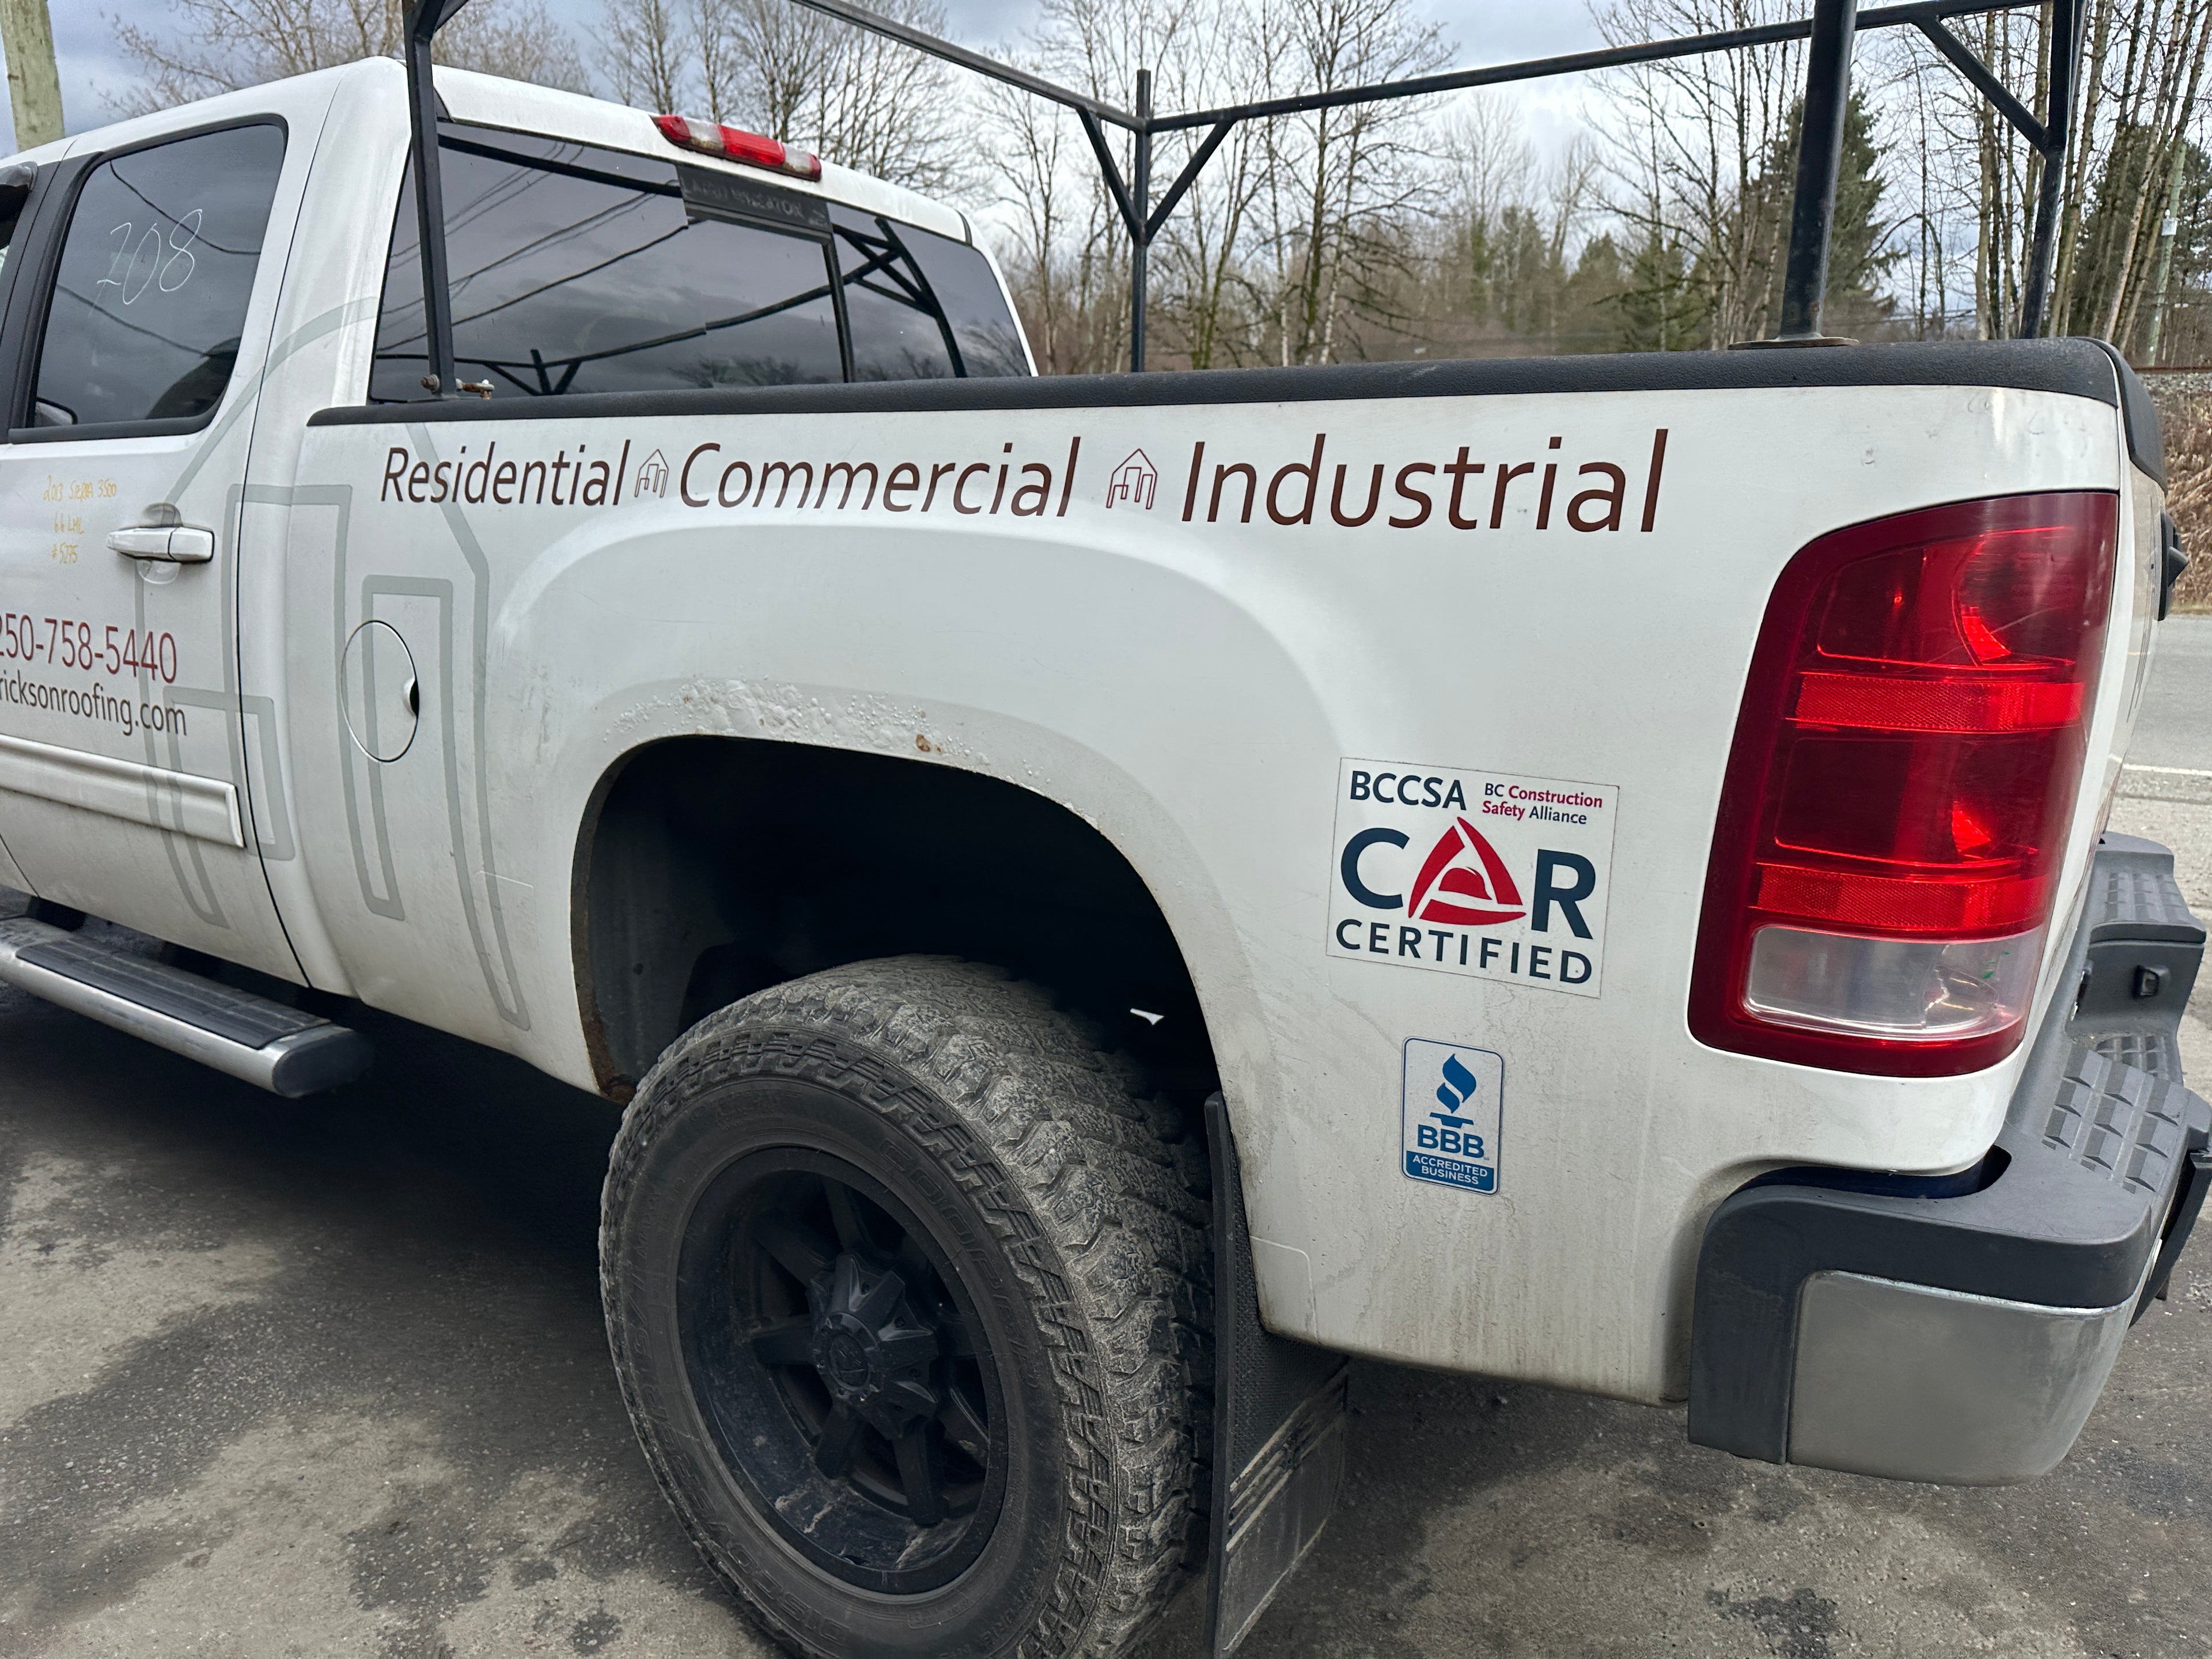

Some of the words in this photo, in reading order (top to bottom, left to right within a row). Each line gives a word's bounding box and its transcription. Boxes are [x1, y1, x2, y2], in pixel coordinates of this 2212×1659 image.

[381, 439, 631, 506] Residential
[680, 436, 1081, 517] Commercial
[1181, 429, 1668, 533] Industrial
[1350, 770, 1467, 811] BCCSA
[1484, 782, 1505, 797] BC
[1508, 785, 1603, 808] Construction
[1482, 800, 1526, 821] Safety
[1528, 805, 1588, 824] Alliance
[1335, 918, 1592, 984] CERTIFIED
[1417, 1124, 1484, 1158] BBB
[1412, 1154, 1488, 1177] ACCREDITED
[1421, 1165, 1479, 1185] BUSINESS
